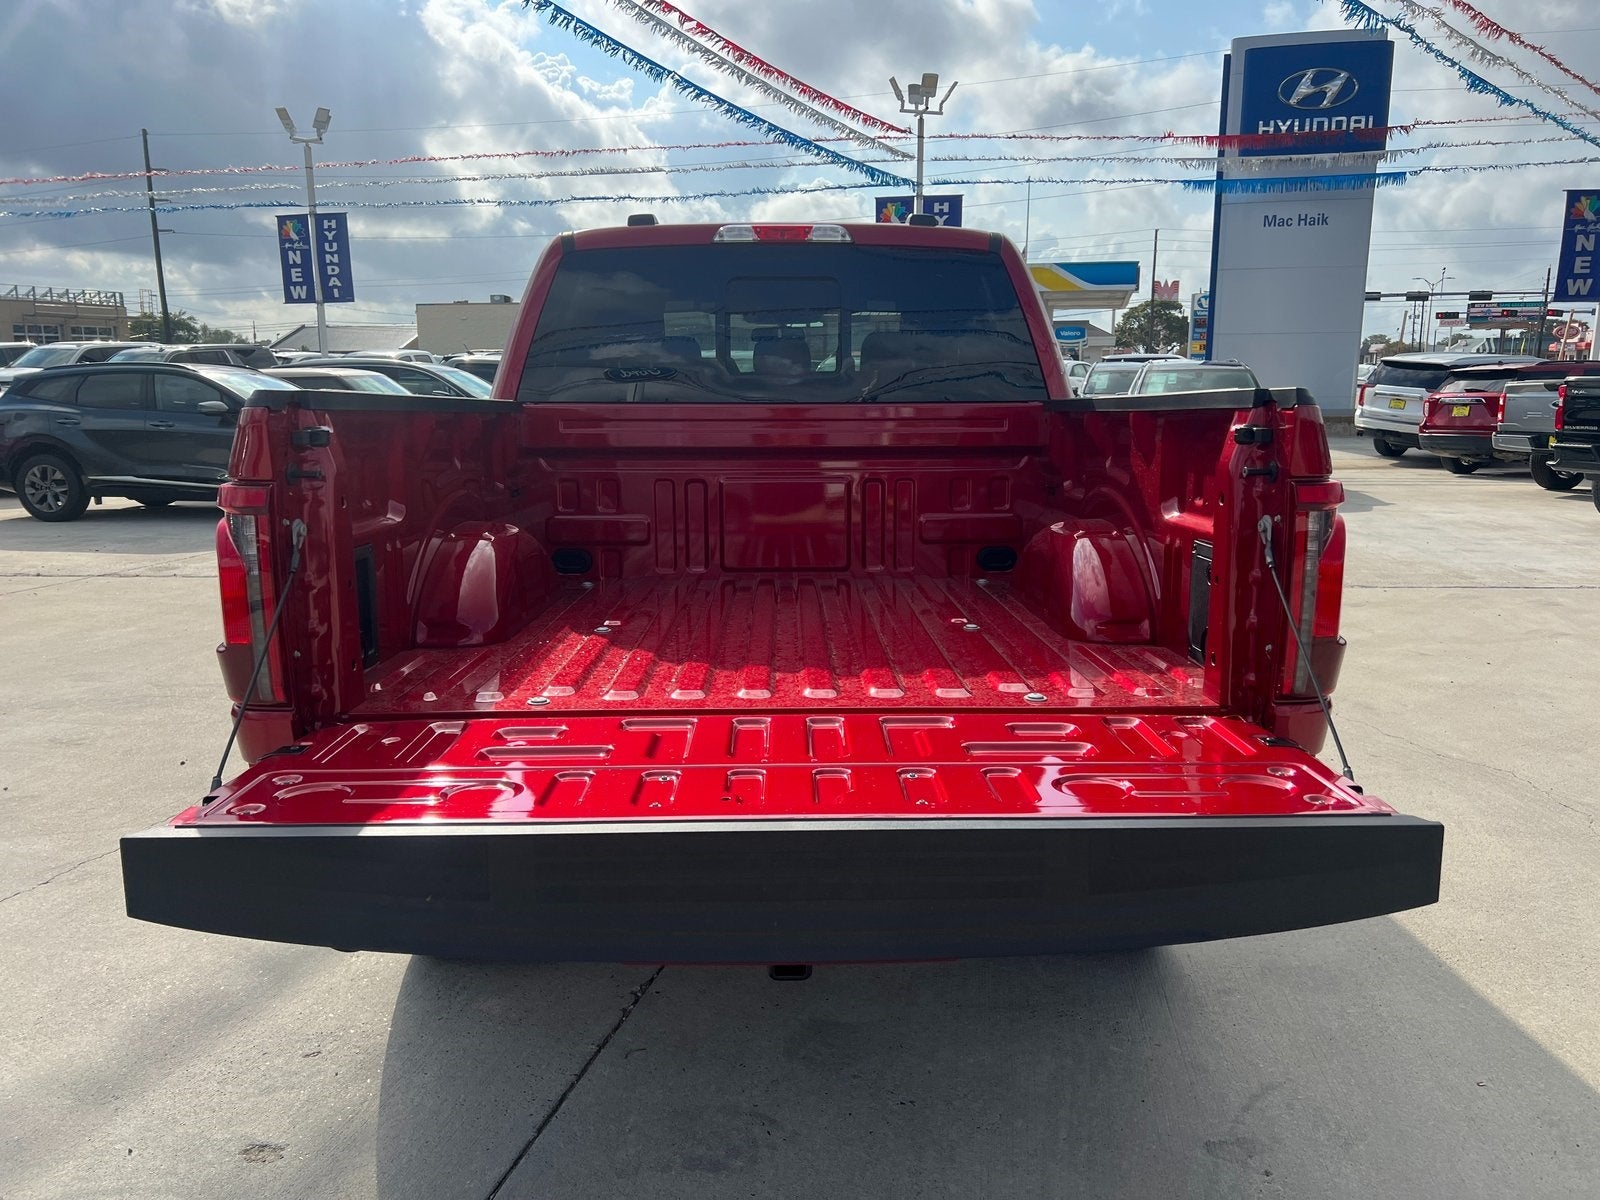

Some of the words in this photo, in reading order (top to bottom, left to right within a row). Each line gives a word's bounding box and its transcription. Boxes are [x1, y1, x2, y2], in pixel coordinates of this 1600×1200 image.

[1258, 115, 1374, 135] HYUNDAI
[1263, 214, 1293, 228] Mac
[1297, 213, 1329, 227] Haik
[288, 250, 307, 300] NEW
[323, 219, 342, 298] HYUNDAI
[1566, 234, 1596, 296] NEW
